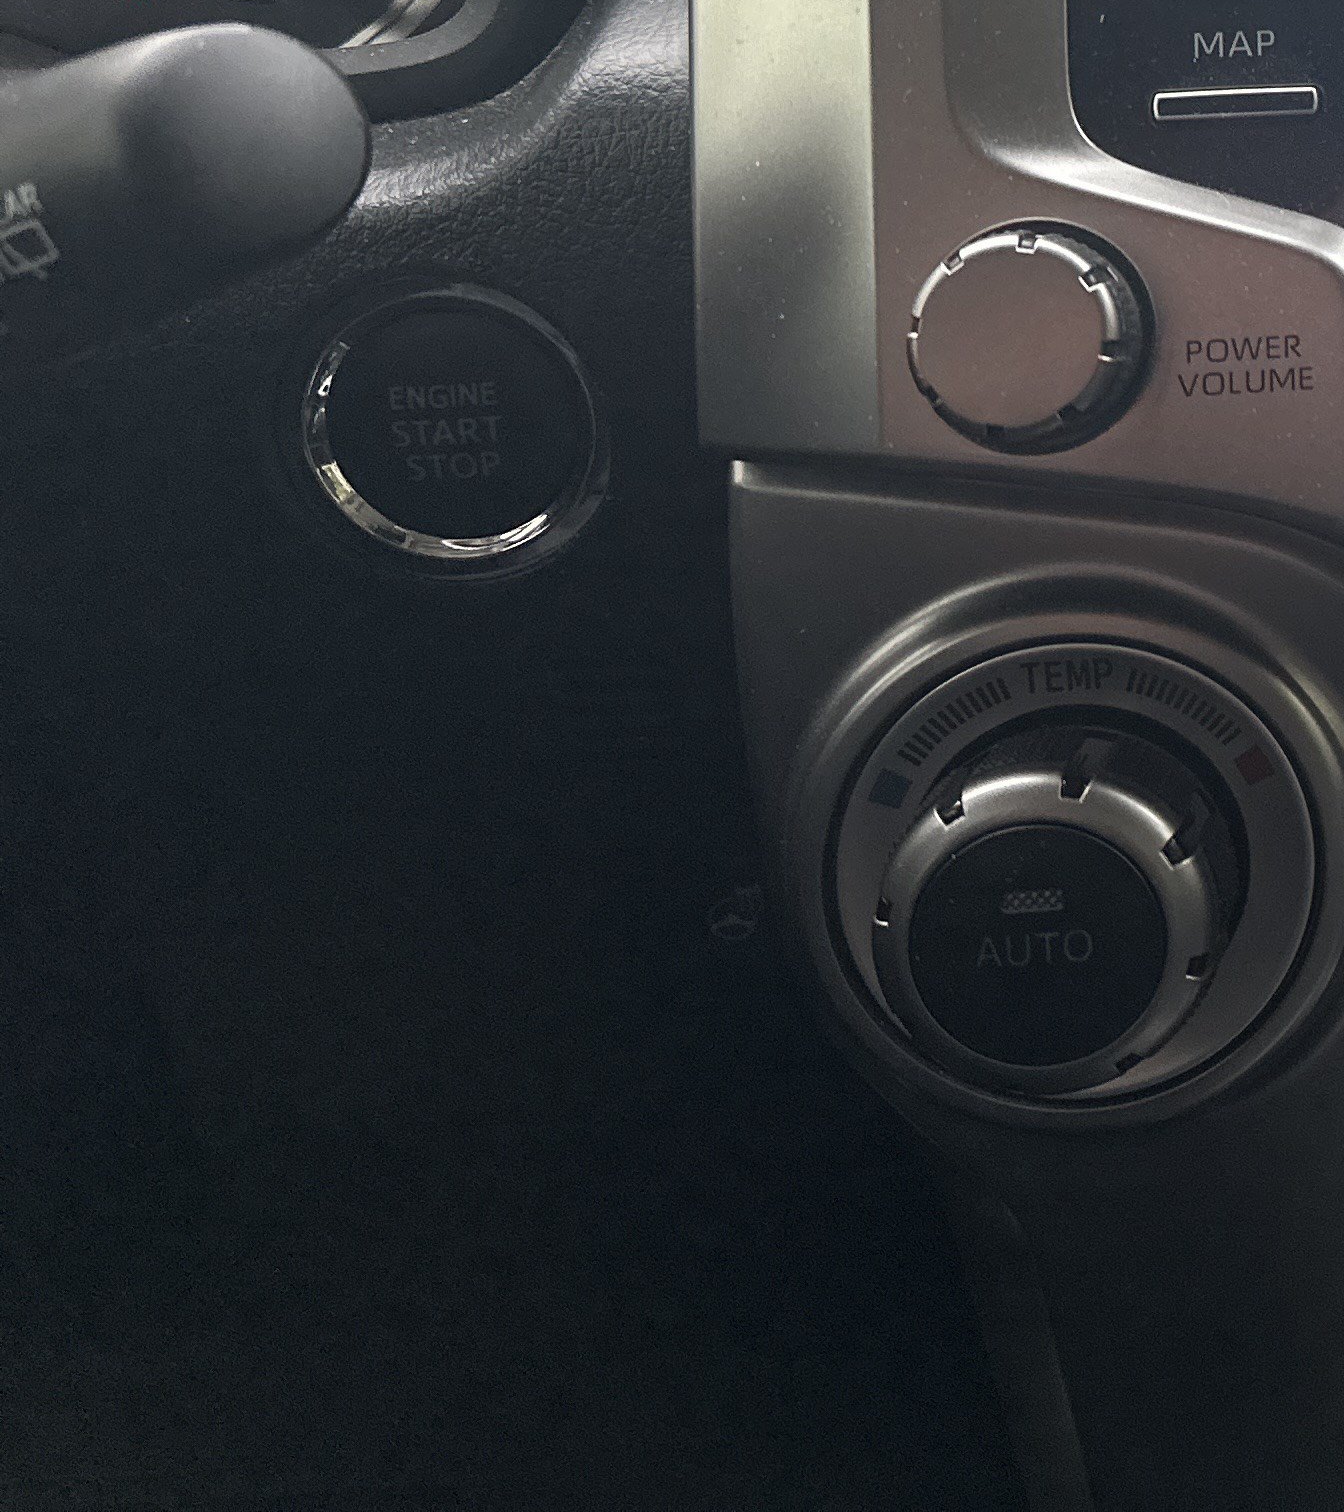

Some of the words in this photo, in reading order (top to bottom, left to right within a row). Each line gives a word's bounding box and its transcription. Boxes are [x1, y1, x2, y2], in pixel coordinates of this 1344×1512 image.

[1192, 31, 1275, 59] MAP
[1185, 335, 1303, 364] POWER
[389, 382, 498, 411] ENGINE
[1178, 366, 1314, 397] VOLUME
[391, 415, 501, 448] START
[406, 452, 501, 482] STOP
[1020, 661, 1113, 694] TEMP
[976, 929, 1094, 968] AUTO
